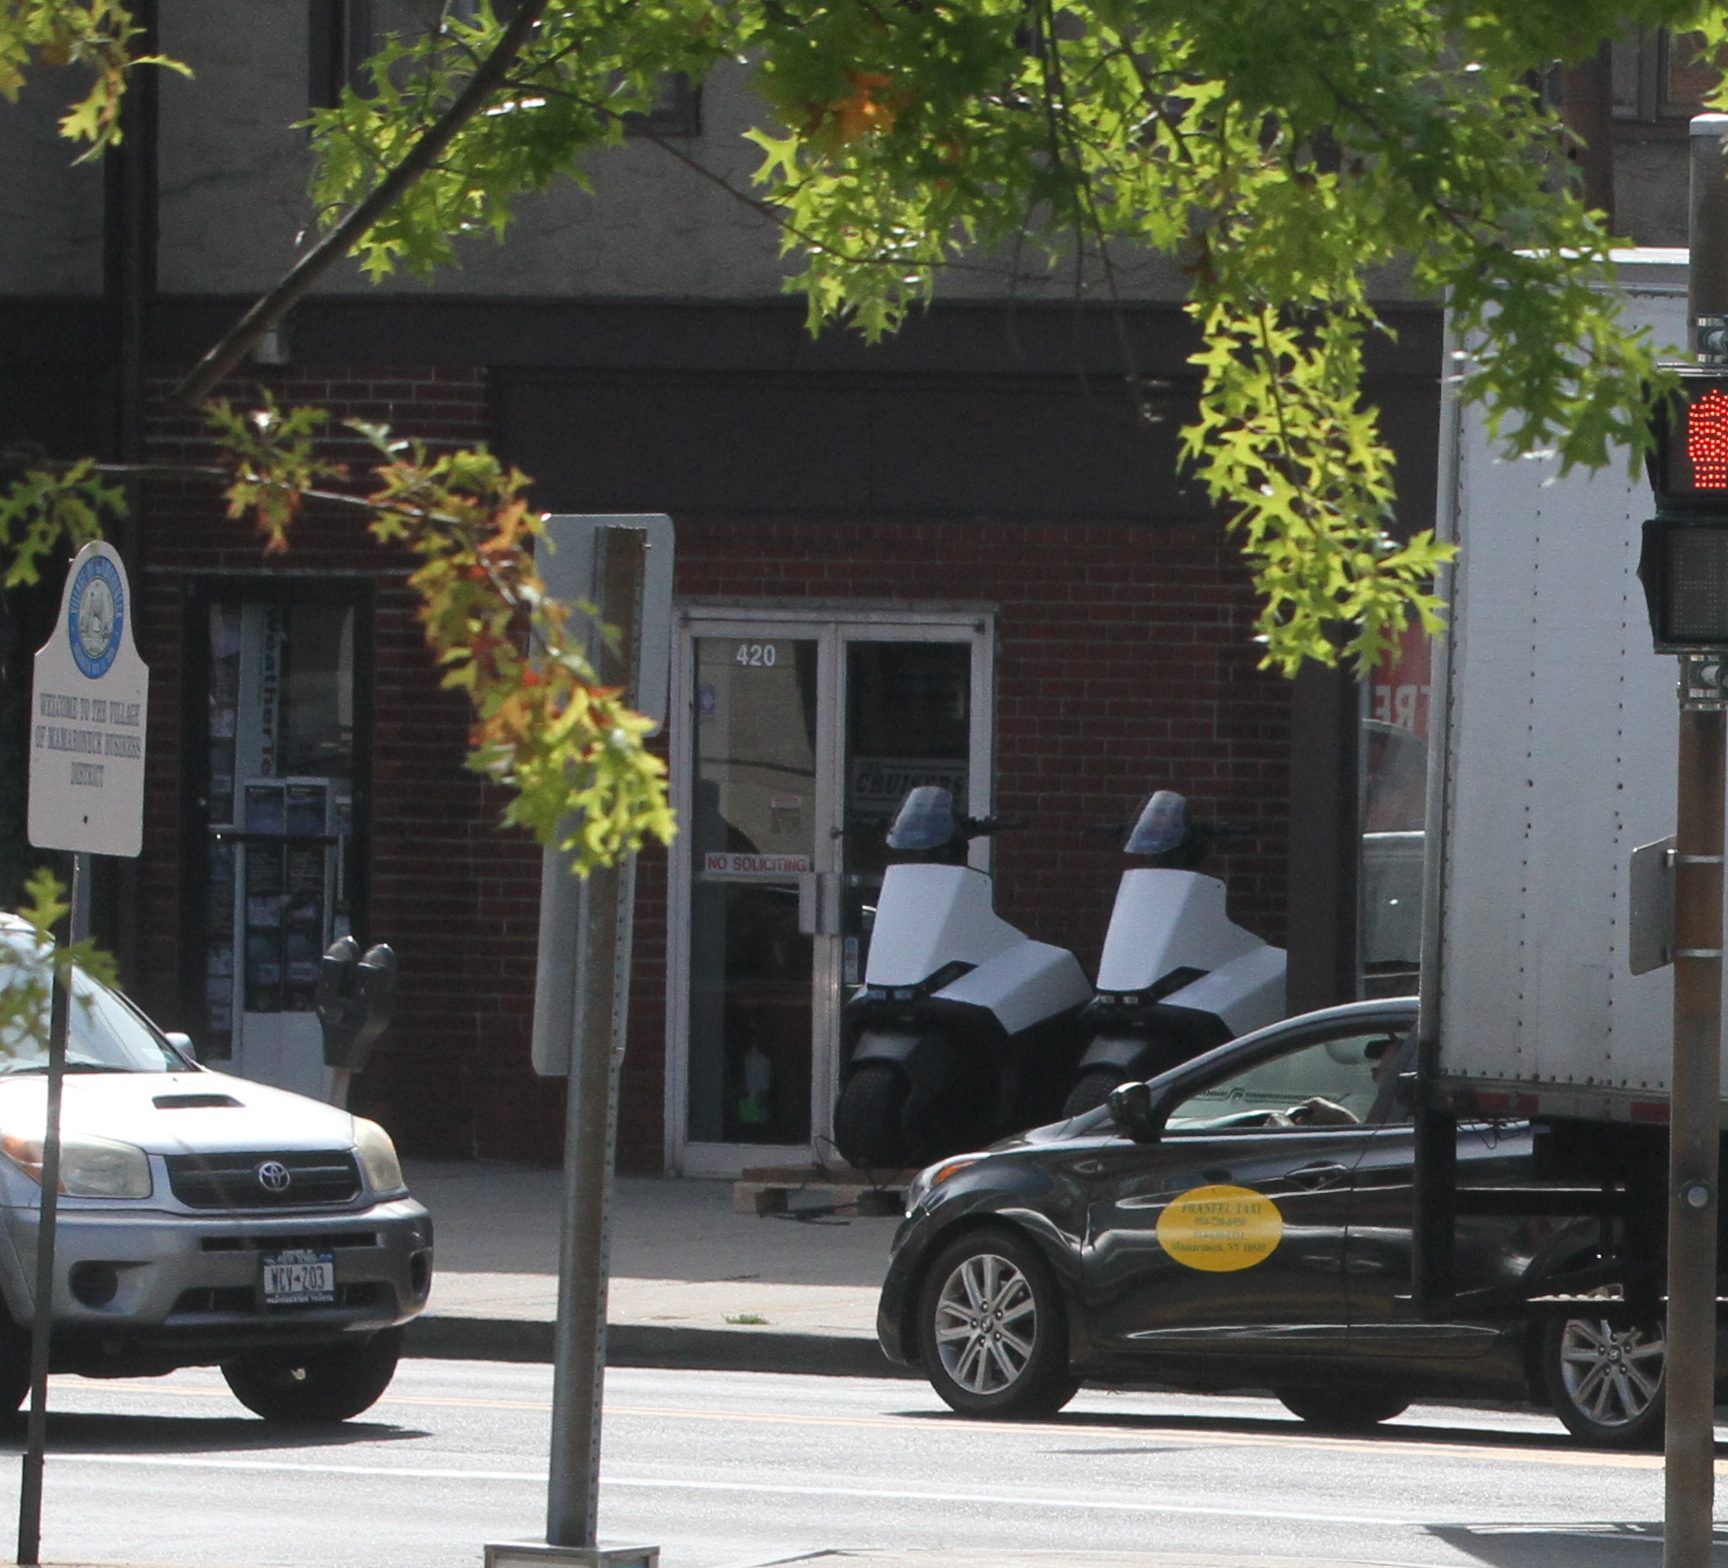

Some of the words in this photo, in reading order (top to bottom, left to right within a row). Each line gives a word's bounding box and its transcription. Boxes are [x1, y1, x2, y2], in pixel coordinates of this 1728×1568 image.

[737, 644, 776, 666] 420
[708, 856, 728, 870] NO
[734, 856, 808, 872] SOLICITING
